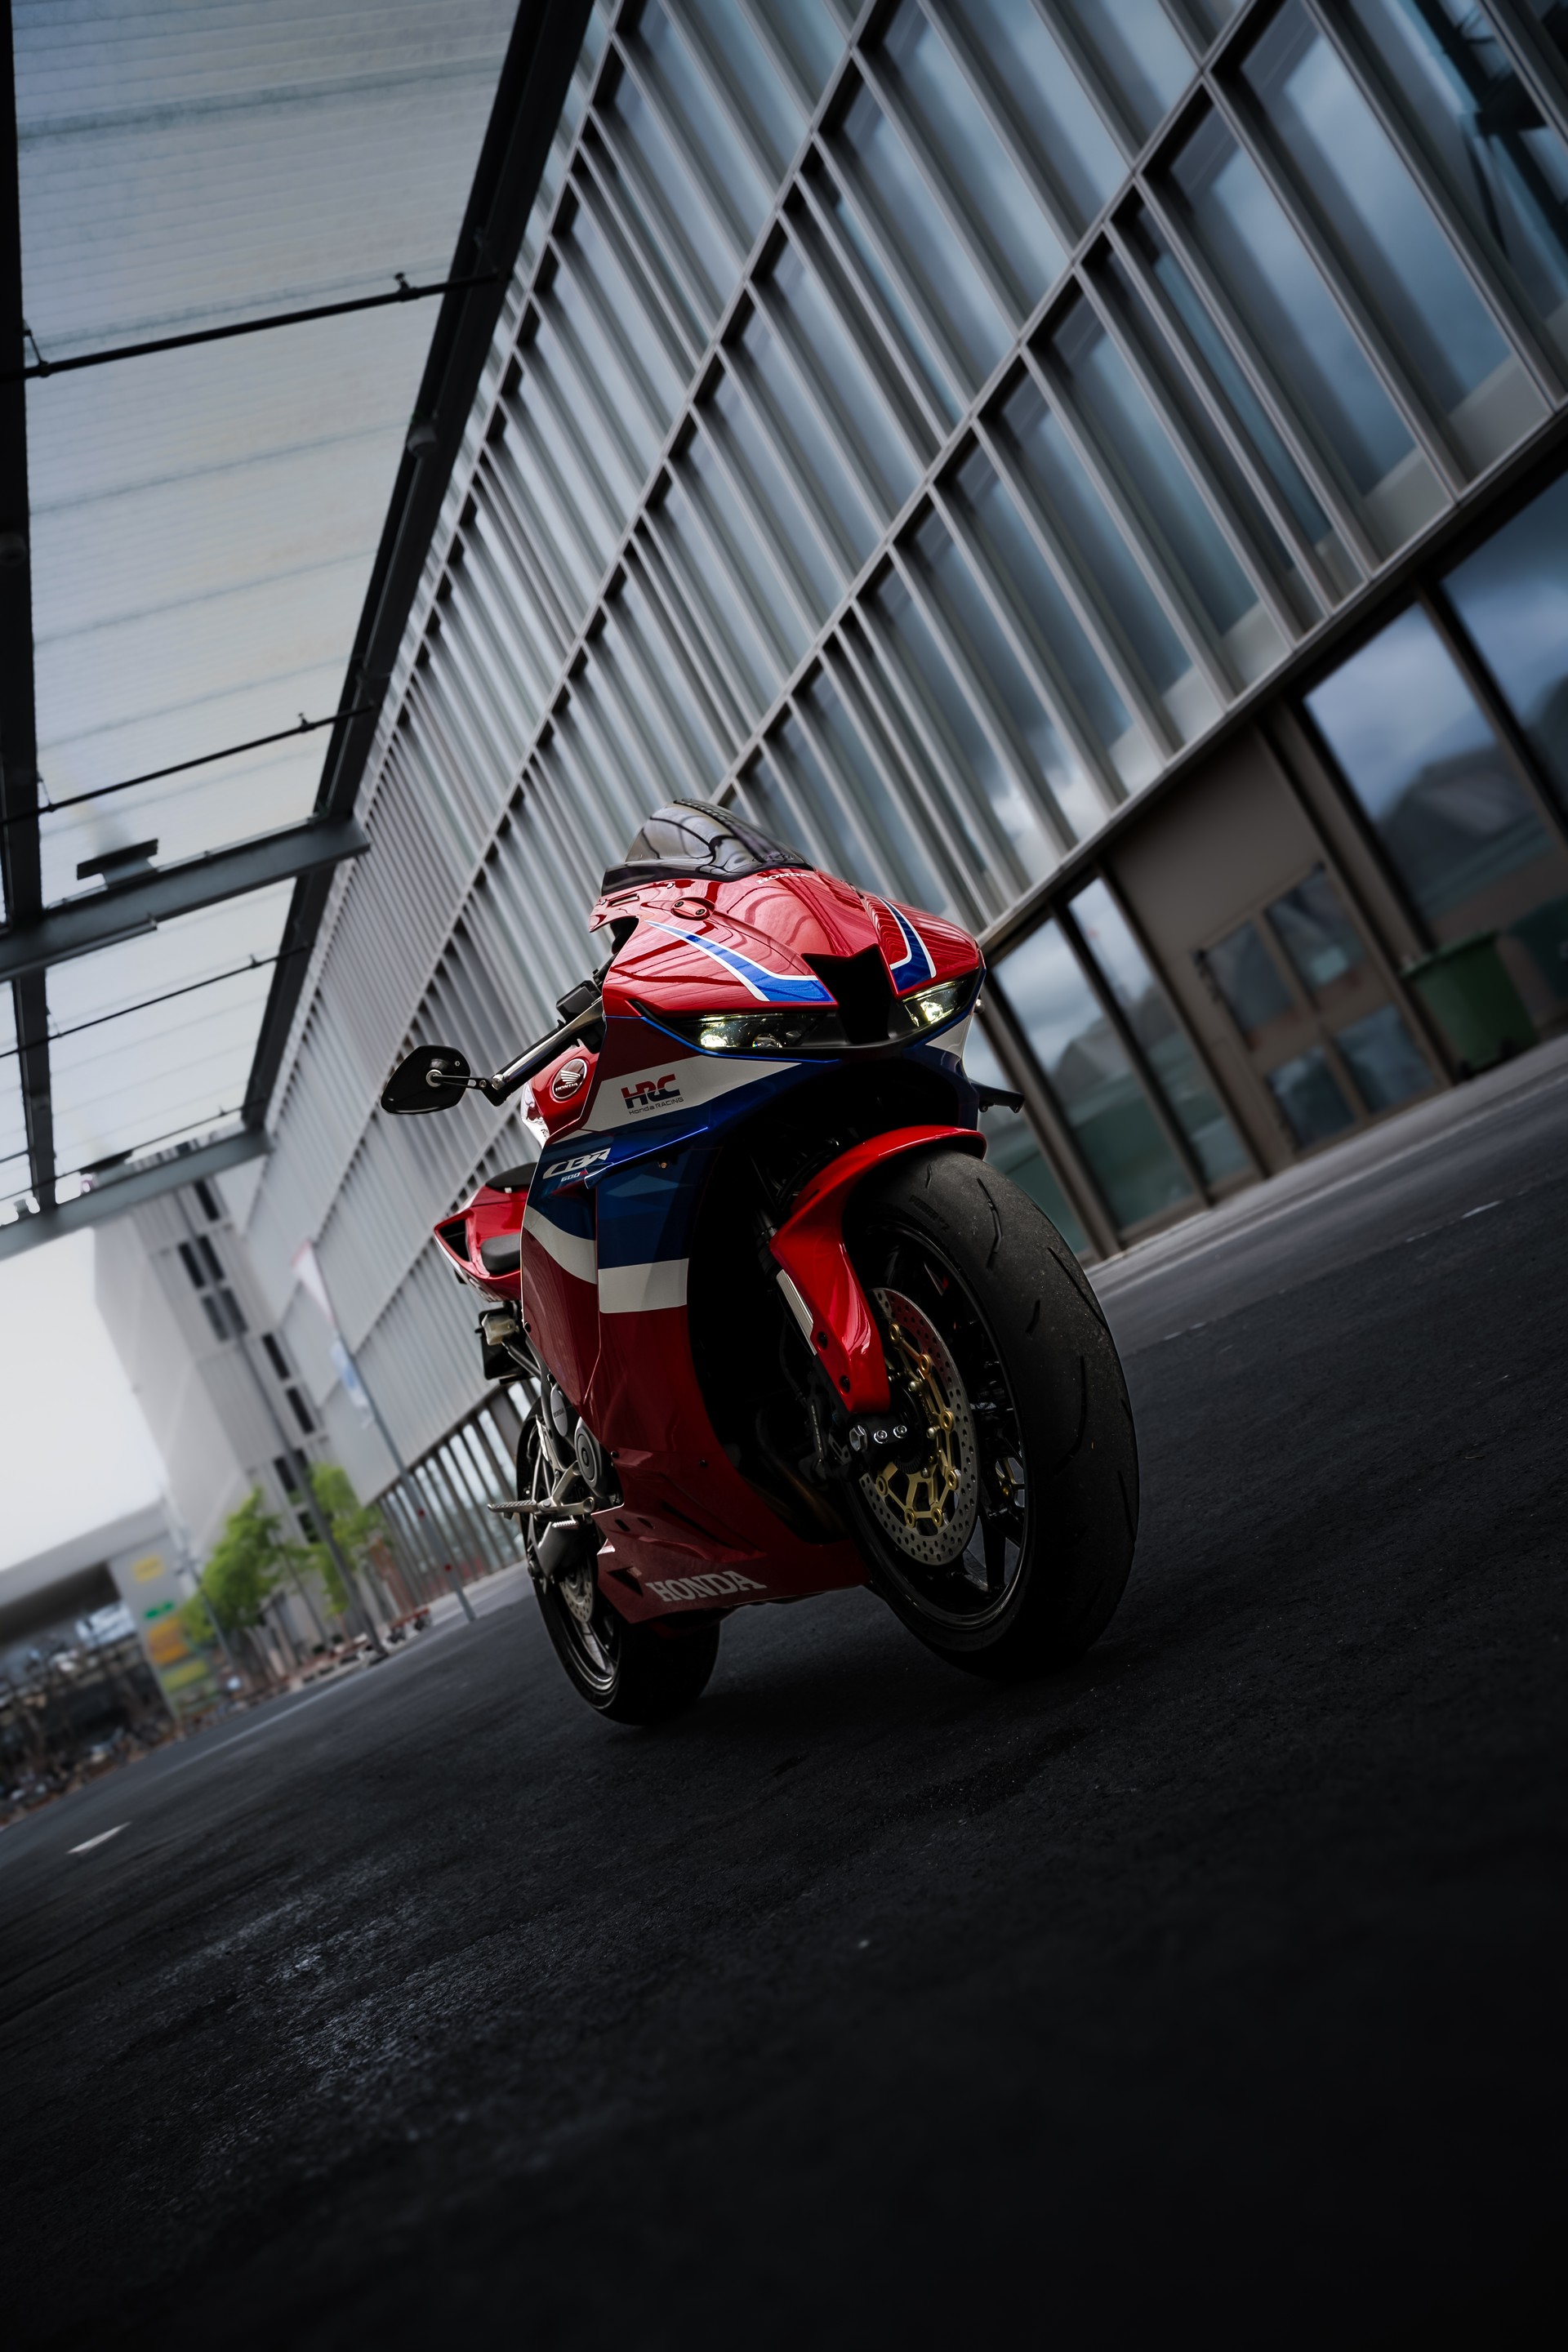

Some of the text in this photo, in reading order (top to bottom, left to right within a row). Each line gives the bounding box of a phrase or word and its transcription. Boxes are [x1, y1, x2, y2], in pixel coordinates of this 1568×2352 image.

[756, 872, 811, 884] HONDA
[555, 1082, 578, 1092] HONDA
[621, 1074, 680, 1109] HRC
[628, 1097, 684, 1116] Honda RACING
[542, 1147, 611, 1180] CBR
[645, 1570, 768, 1602] HONDA
